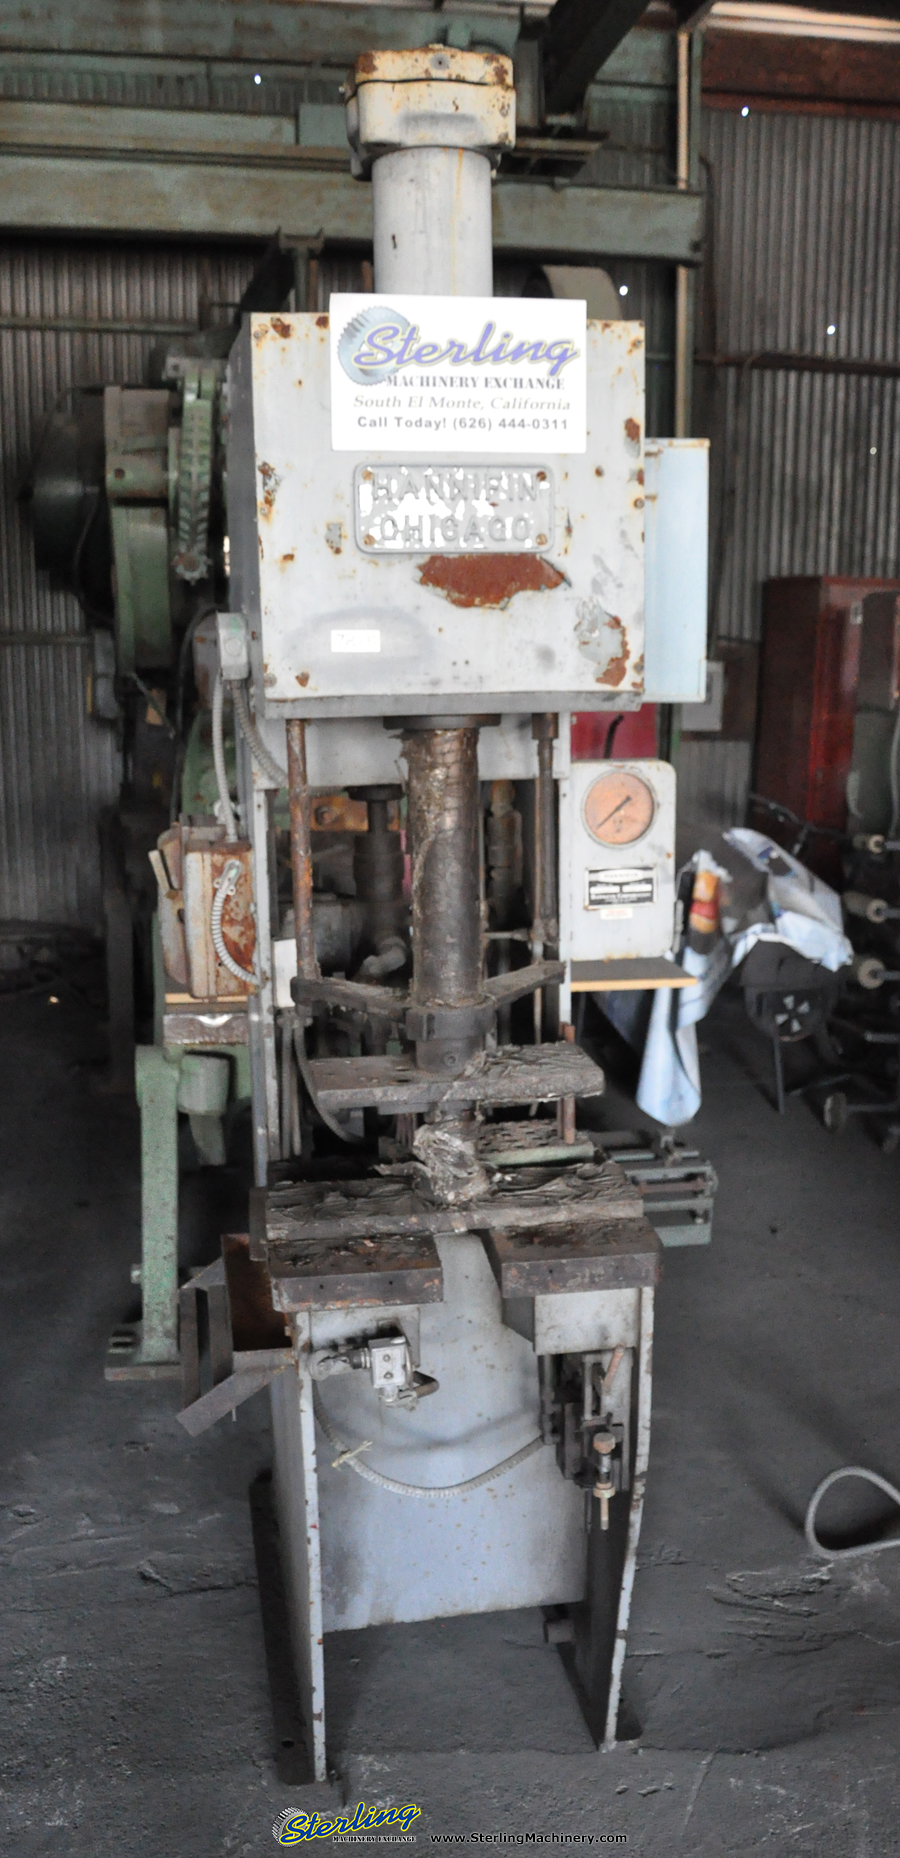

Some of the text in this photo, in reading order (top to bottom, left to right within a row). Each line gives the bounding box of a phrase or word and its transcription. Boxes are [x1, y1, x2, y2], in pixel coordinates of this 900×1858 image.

[352, 320, 580, 377] Sterling
[386, 376, 565, 390] MACHINERY EXCHANGE
[353, 395, 571, 411] South El Monte, California
[357, 416, 568, 431] Call Today! (626) 444-0311
[372, 472, 538, 501] HANNIFIN
[379, 514, 530, 543] CHICAGO
